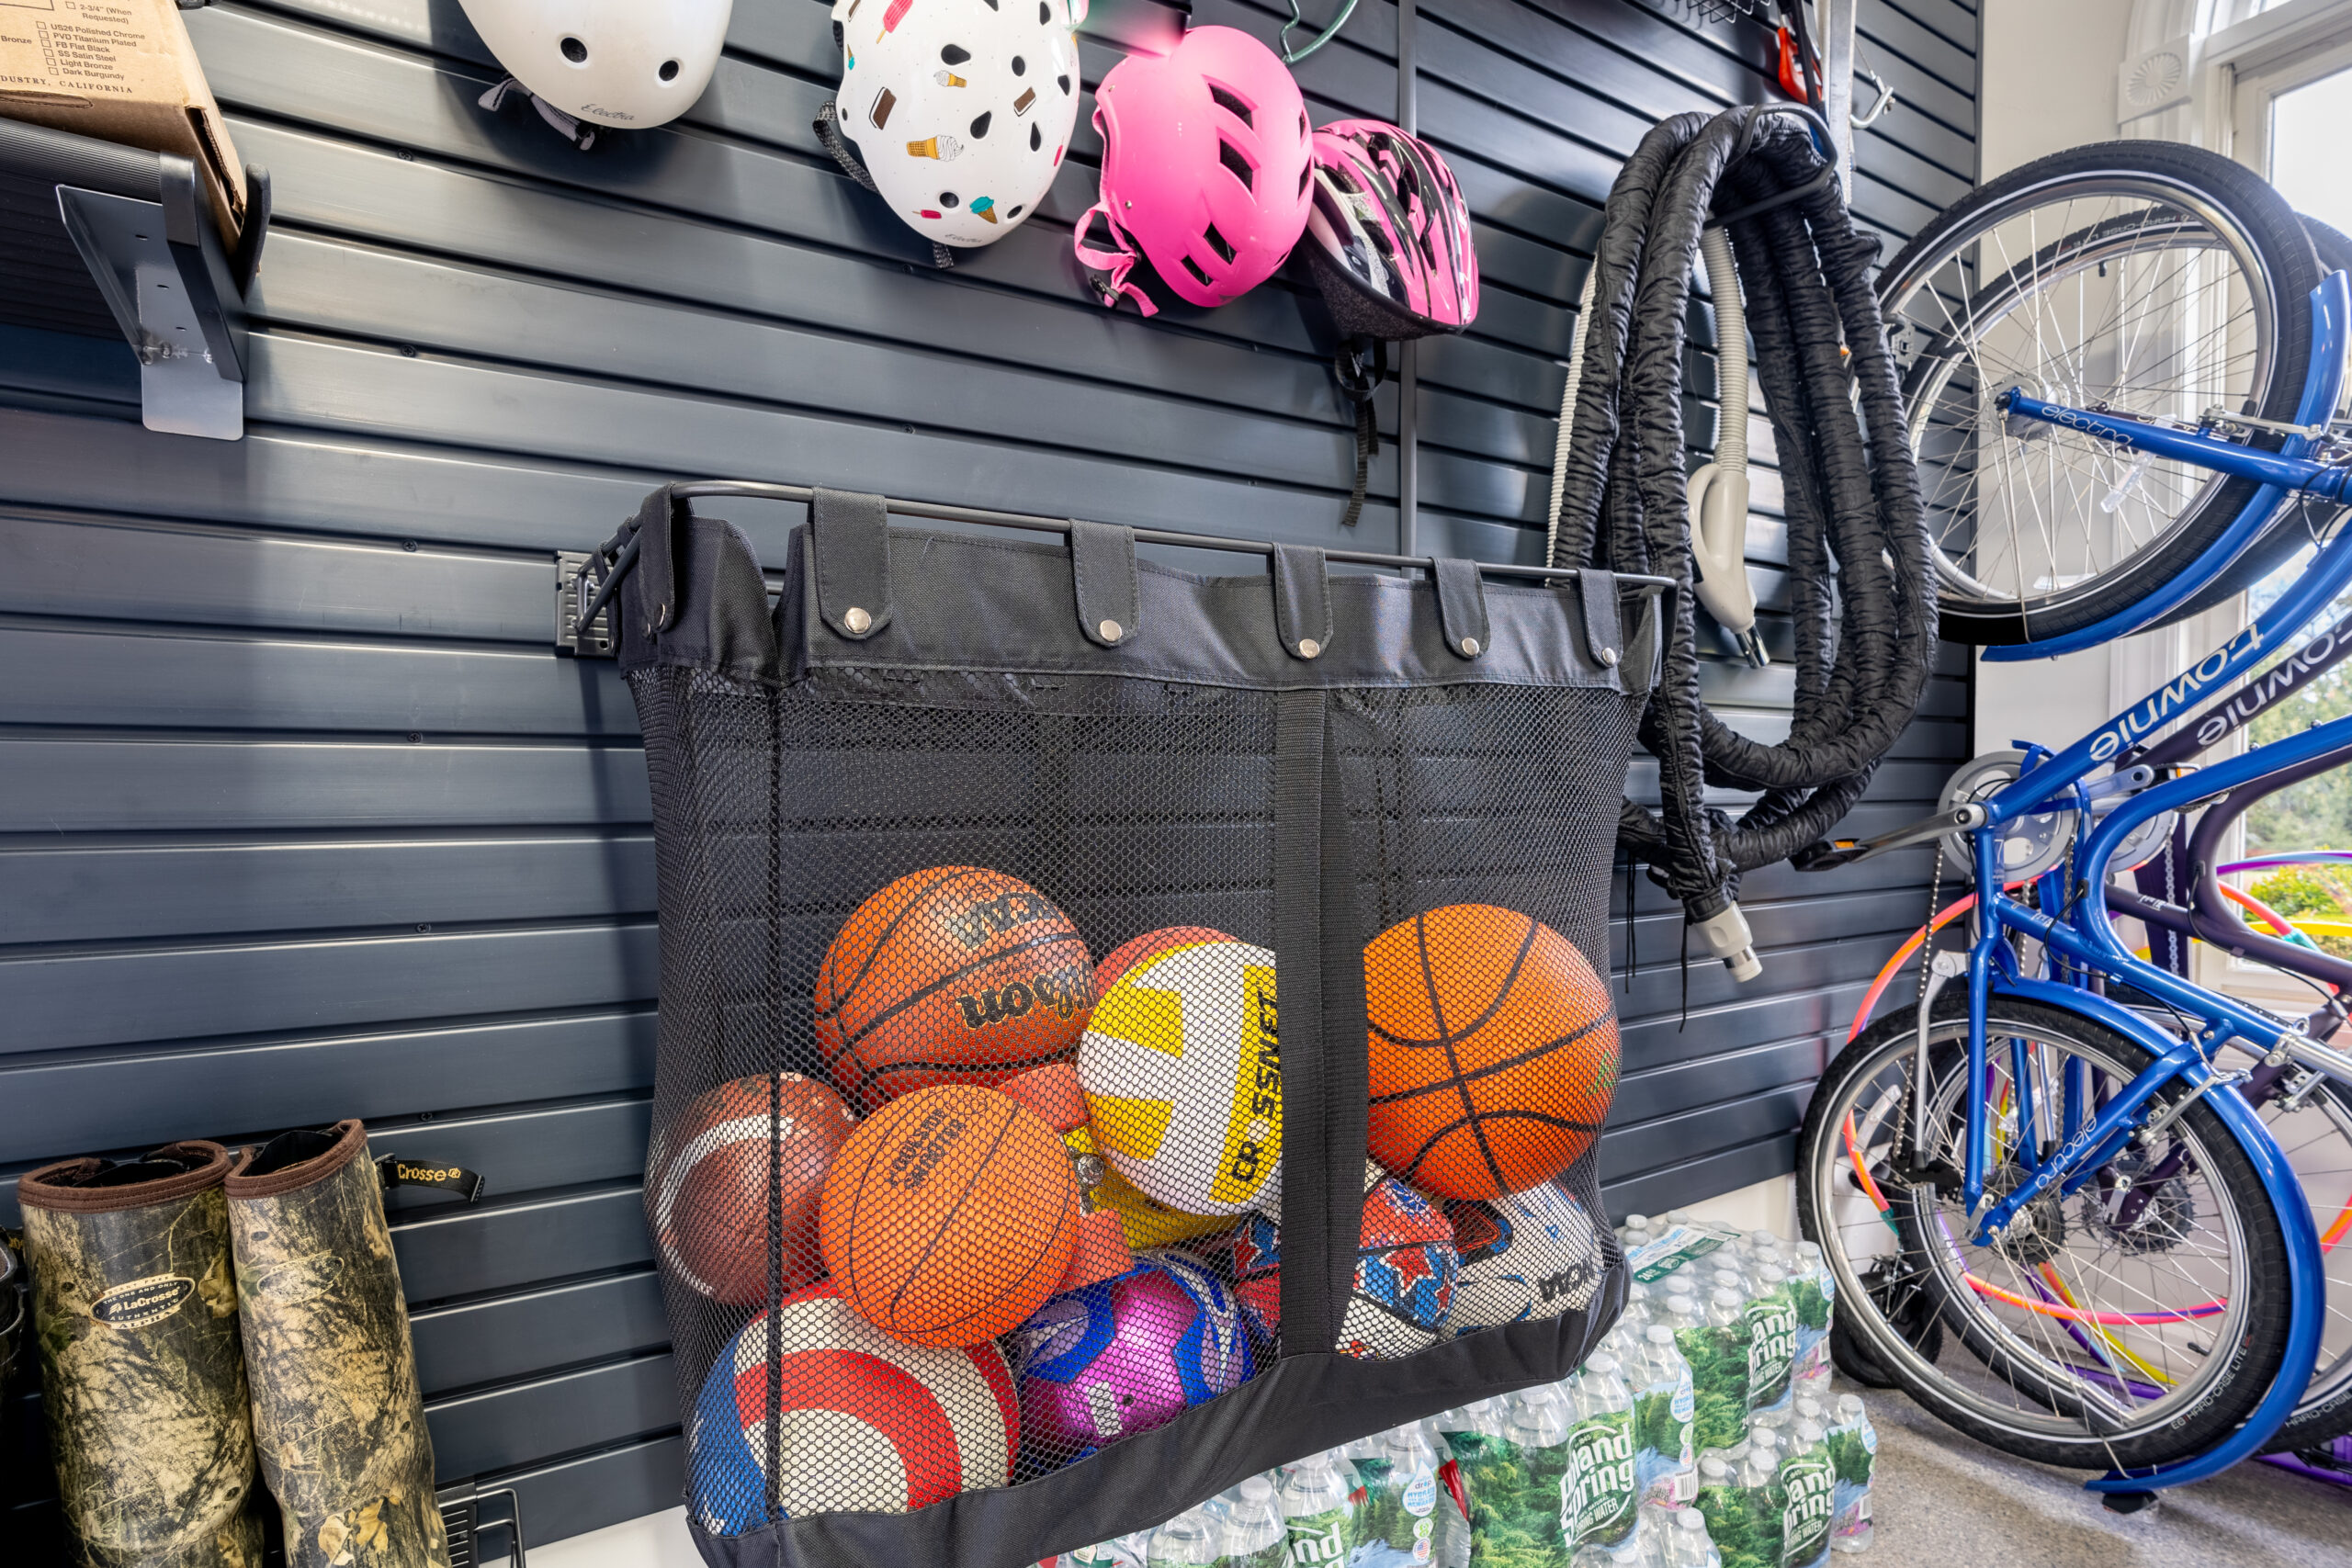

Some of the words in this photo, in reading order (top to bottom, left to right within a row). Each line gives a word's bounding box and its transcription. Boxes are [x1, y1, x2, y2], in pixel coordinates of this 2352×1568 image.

[106, 6, 132, 16] (When
[82, 13, 130, 24] Requested)
[75, 27, 111, 36] Polished
[113, 31, 145, 39] Chrome
[1, 36, 32, 44] Bronze
[74, 35, 109, 44] Titanium
[111, 39, 137, 47] Plated
[88, 45, 110, 53] Black
[72, 51, 94, 60] Satin
[96, 54, 117, 62] Steel
[61, 59, 82, 68] Light
[84, 62, 114, 71] Bronze
[85, 71, 125, 81] Burgundy
[59, 81, 133, 93] CALIFORNIA
[581, 103, 634, 120] Electra
[2041, 405, 2134, 446] electra
[2089, 623, 2265, 761] townie
[1994, 839, 2004, 863] 7
[2035, 1116, 2097, 1190] electra
[138, 1286, 155, 1294] AND
[109, 1298, 179, 1321] AUTHENTIC
[2187, 1370, 2235, 1420] HARD-CASE
[2231, 1345, 2248, 1371] LITE
[1594, 1497, 1620, 1522] WATER
